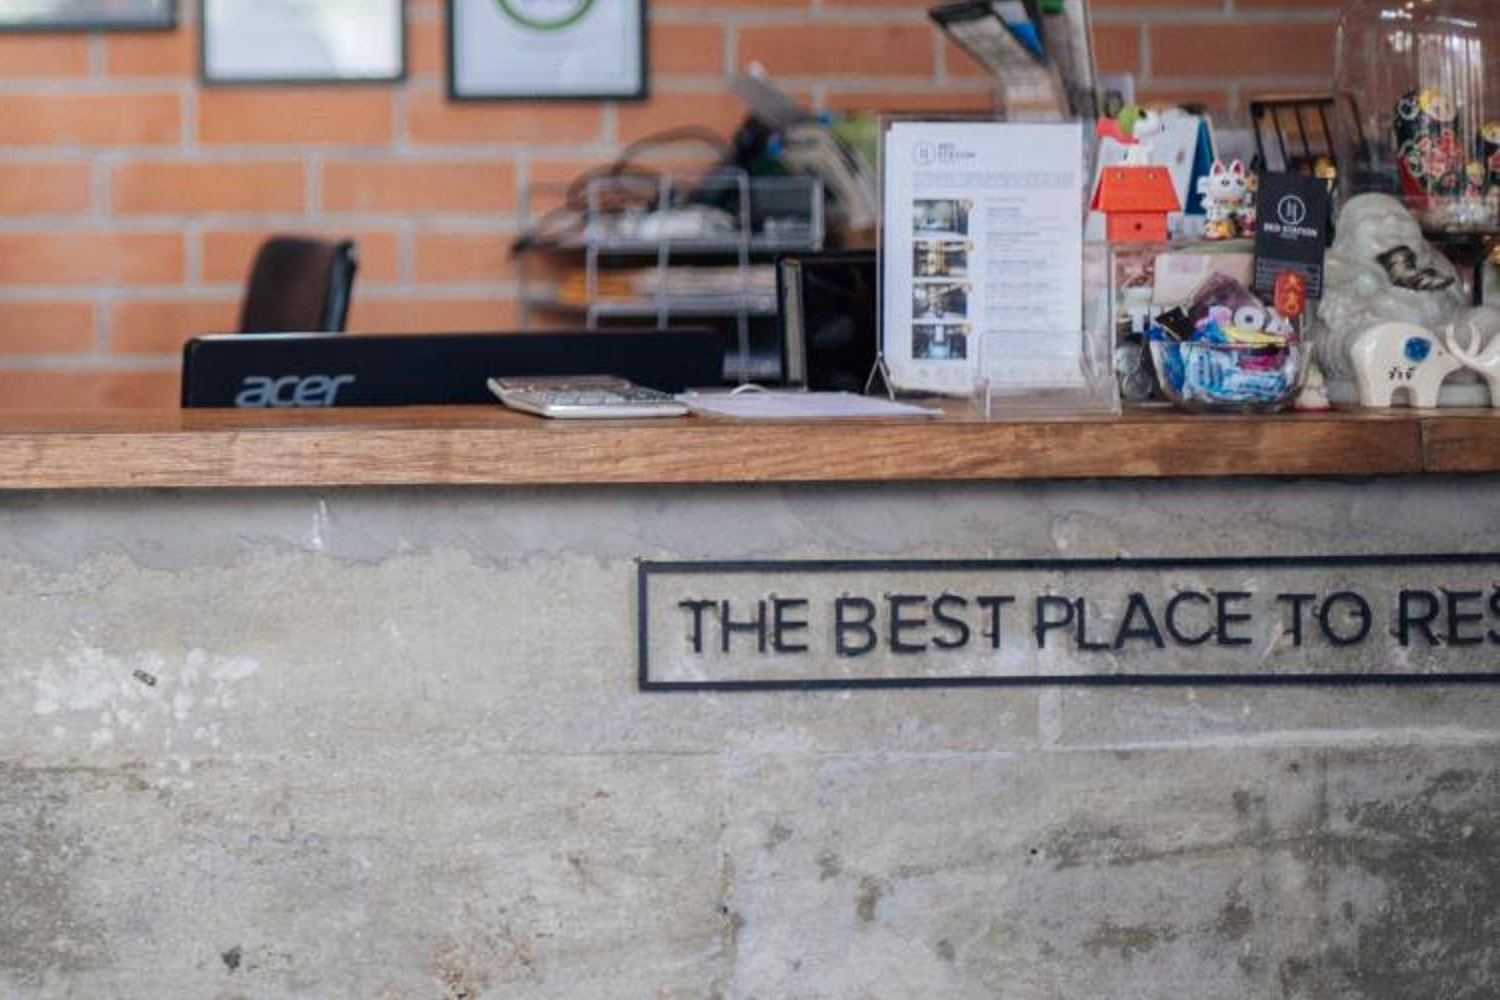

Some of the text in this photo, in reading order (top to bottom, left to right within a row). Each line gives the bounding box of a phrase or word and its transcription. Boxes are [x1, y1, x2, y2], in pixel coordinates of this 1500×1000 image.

[233, 374, 356, 408] acer
[678, 597, 809, 653] THE
[835, 593, 1016, 656] BEST
[1033, 590, 1252, 651] PLACE
[1277, 590, 1372, 648] TO
